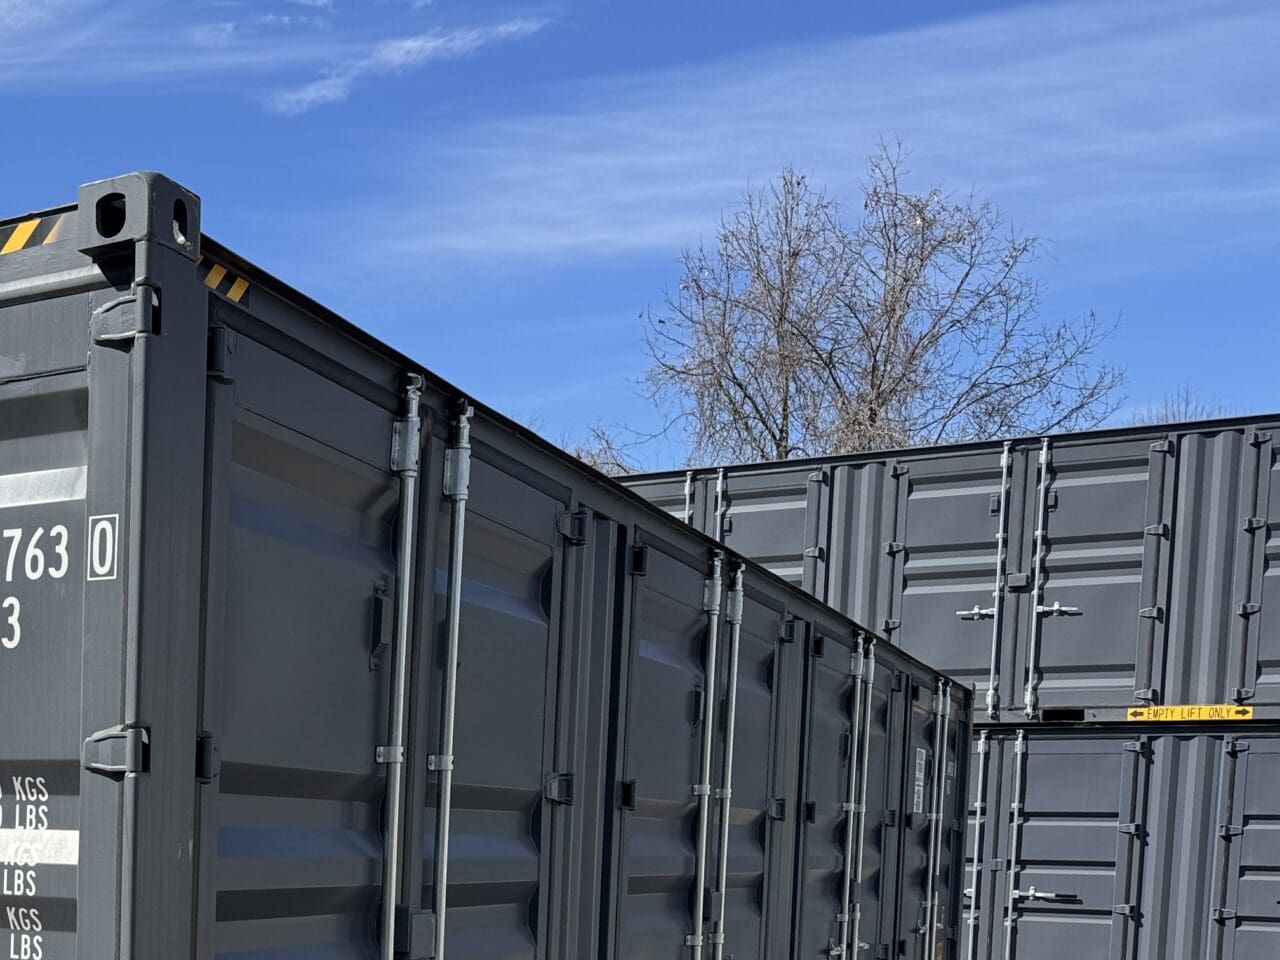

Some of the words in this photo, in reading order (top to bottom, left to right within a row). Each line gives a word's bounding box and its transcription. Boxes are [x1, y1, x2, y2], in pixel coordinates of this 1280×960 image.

[91, 519, 115, 576] 0
[1147, 708, 1175, 719] EMPTY
[1180, 708, 1204, 719] LIFT
[1208, 707, 1232, 719] ONLY
[12, 775, 49, 802] KGS
[15, 803, 49, 830] LBS
[3, 868, 37, 896] LBS
[6, 906, 42, 932] KGS
[10, 933, 43, 960] LBS
